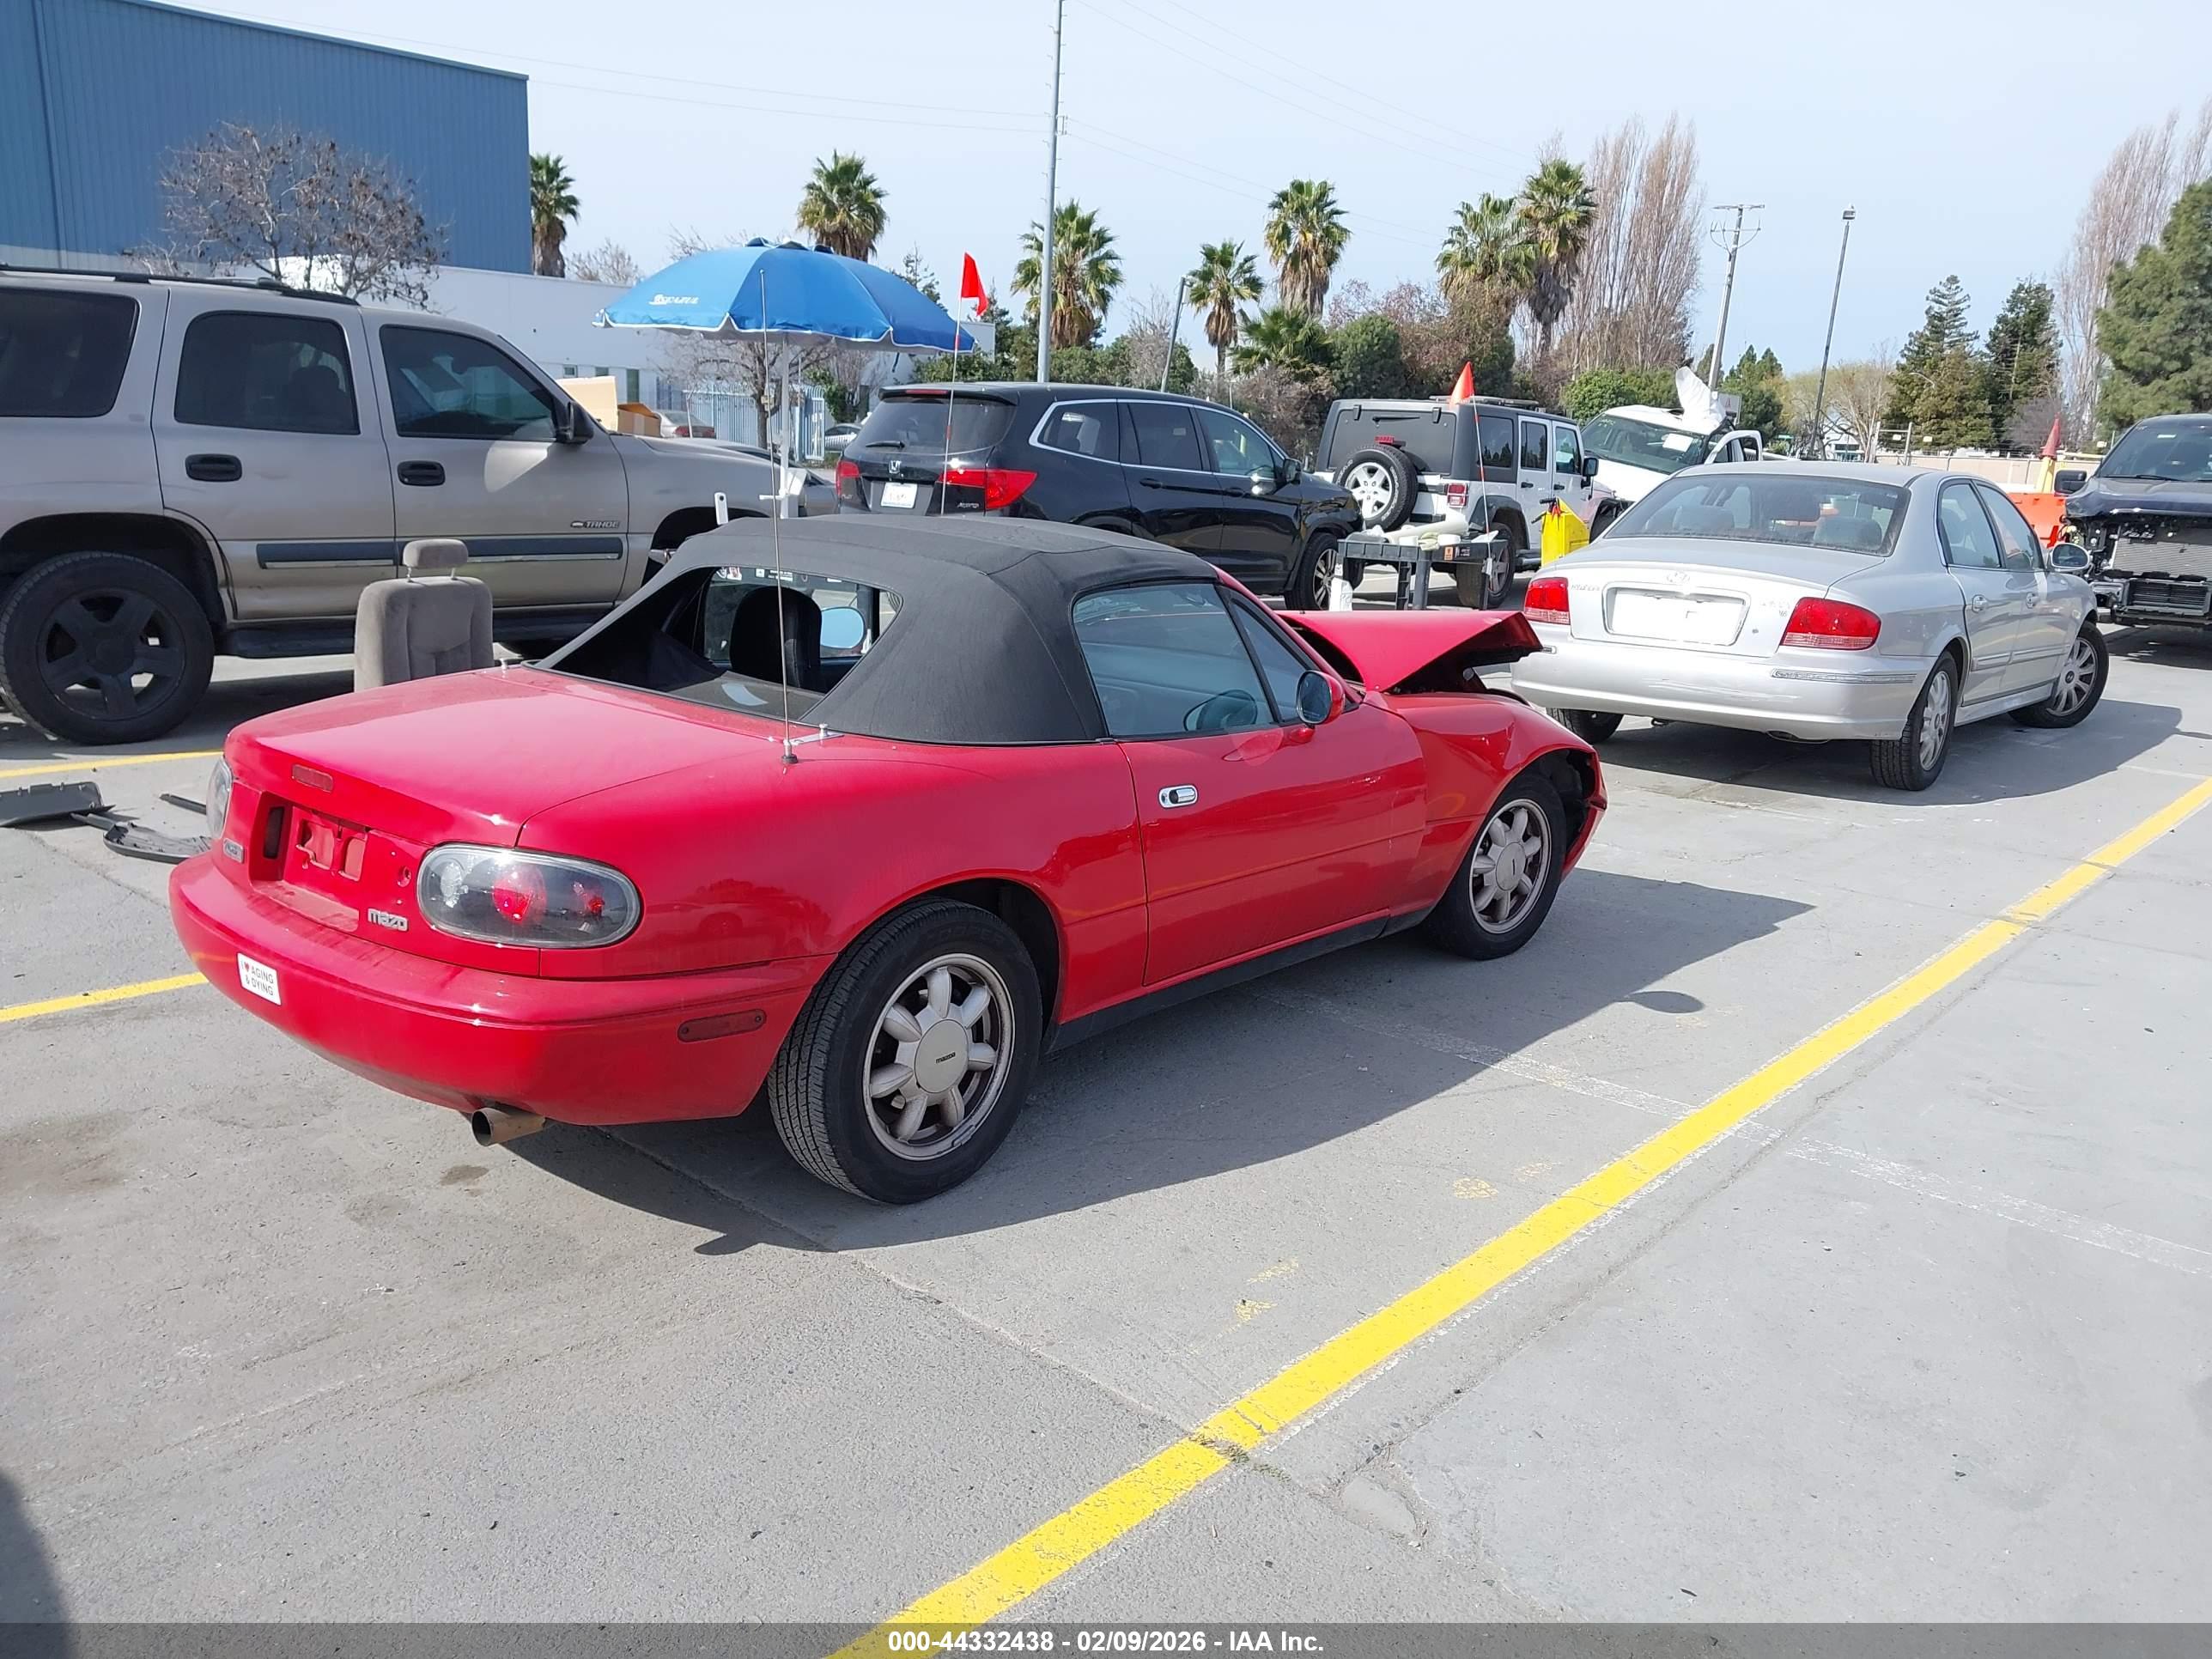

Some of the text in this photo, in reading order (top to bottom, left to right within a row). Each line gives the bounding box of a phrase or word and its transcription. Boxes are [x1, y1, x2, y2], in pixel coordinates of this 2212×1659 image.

[585, 520, 619, 529] TAHOE
[251, 966, 274, 984] AGING
[251, 977, 274, 996] DYING
